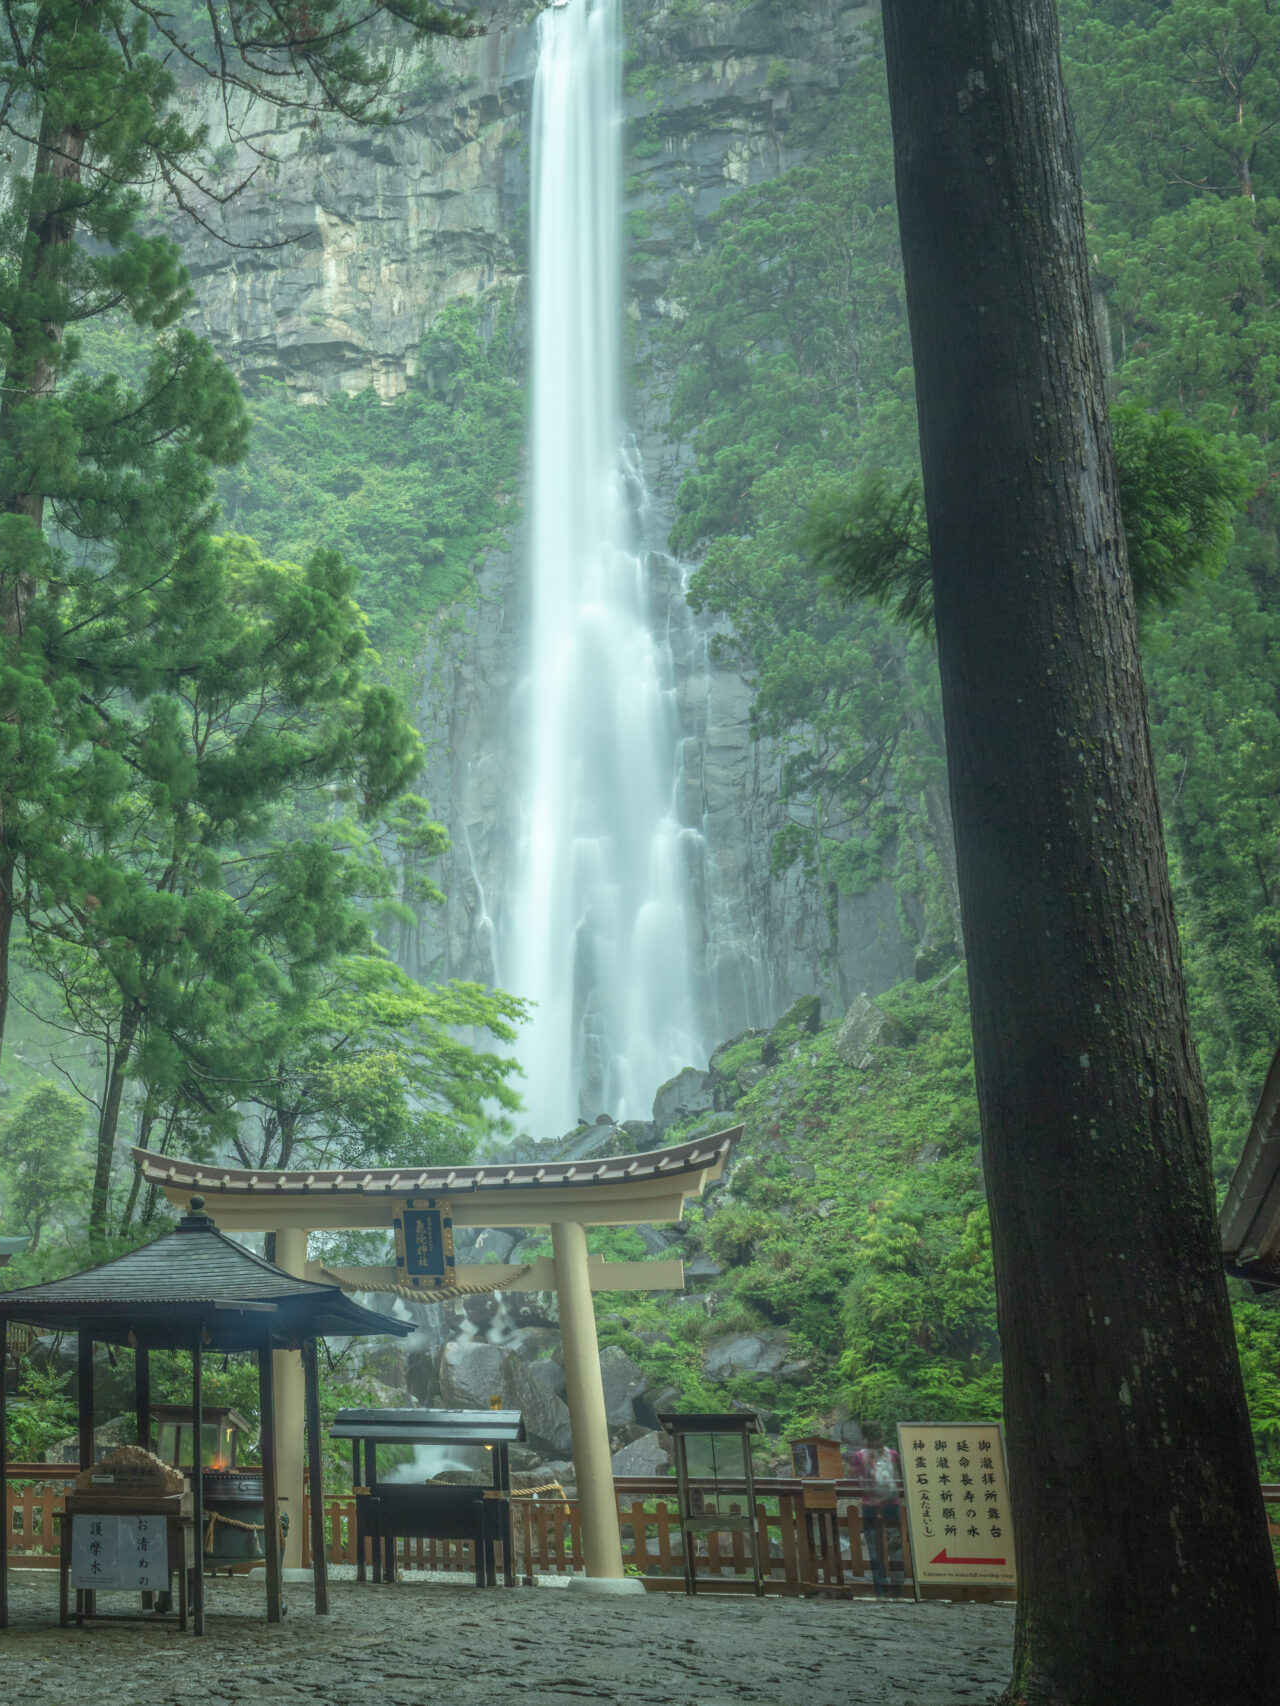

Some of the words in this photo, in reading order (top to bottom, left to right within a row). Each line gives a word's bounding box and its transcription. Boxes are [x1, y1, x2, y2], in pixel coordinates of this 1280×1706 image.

[934, 1440, 957, 1536] 御瀧本祈願所
[956, 1440, 980, 1538] 延命長寿の水
[978, 1440, 1002, 1538] 御瀧拝所舞台
[89, 1521, 103, 1575] 護摩木
[136, 1518, 150, 1586] お清めの
